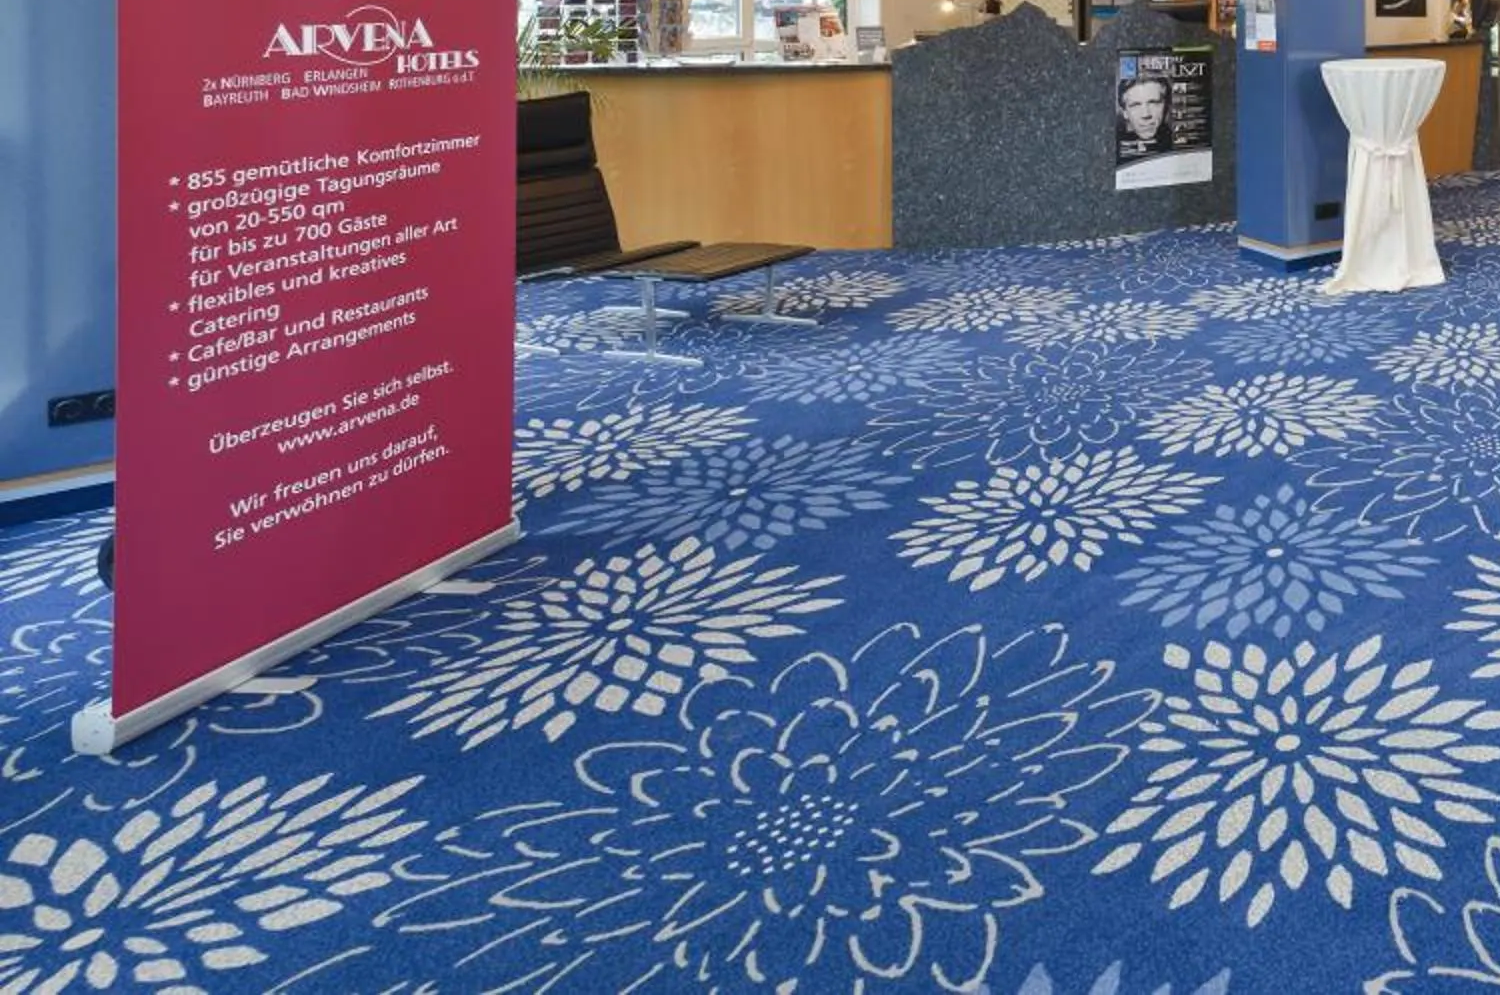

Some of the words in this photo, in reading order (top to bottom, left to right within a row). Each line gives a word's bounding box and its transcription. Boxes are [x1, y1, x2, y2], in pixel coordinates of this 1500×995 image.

[262, 5, 434, 65] ARVENA
[396, 49, 480, 74] HOTELS
[203, 89, 269, 107] BAYREUTH
[281, 85, 309, 100] BAD
[313, 79, 382, 97] WINDSHEIM
[303, 66, 368, 83] ERLANGEN
[187, 168, 226, 190] 855
[232, 153, 349, 187] gemütliche
[356, 135, 481, 165] Komfortzimmer
[187, 183, 310, 219] großzügige
[316, 161, 441, 194] Tagungsräume
[188, 245, 222, 264] für
[228, 238, 257, 256] bis
[263, 233, 287, 249] zu
[294, 222, 332, 242] 700
[337, 213, 388, 235] Gäste
[189, 220, 229, 238] von
[235, 204, 306, 231] 20-550
[311, 200, 345, 220] qm
[188, 269, 222, 288] für
[228, 234, 391, 280] Veranstaltungen
[395, 225, 428, 244] aller
[432, 217, 459, 236] Art
[187, 282, 276, 314] flexibles
[281, 268, 323, 292] und
[328, 252, 408, 281] kreatives
[187, 328, 278, 363] Cafe/Bar
[284, 312, 326, 336] und
[331, 287, 430, 326] Restaurants
[189, 304, 281, 338] Catering
[187, 350, 281, 392] günstige
[286, 311, 417, 359] Arrangements
[209, 401, 337, 454] Überzeugen
[342, 392, 369, 411] Sie
[373, 377, 402, 401] sich
[405, 361, 454, 388] selbst.
[277, 393, 420, 454] www.arvena.de
[214, 527, 246, 550] Sie
[250, 480, 364, 534] verwöhnen
[368, 469, 389, 488] zu
[392, 444, 450, 477] dürfen.
[229, 492, 268, 518] Wir
[273, 466, 342, 502] freuen
[347, 452, 379, 474] uns
[382, 423, 438, 460] darauf,
